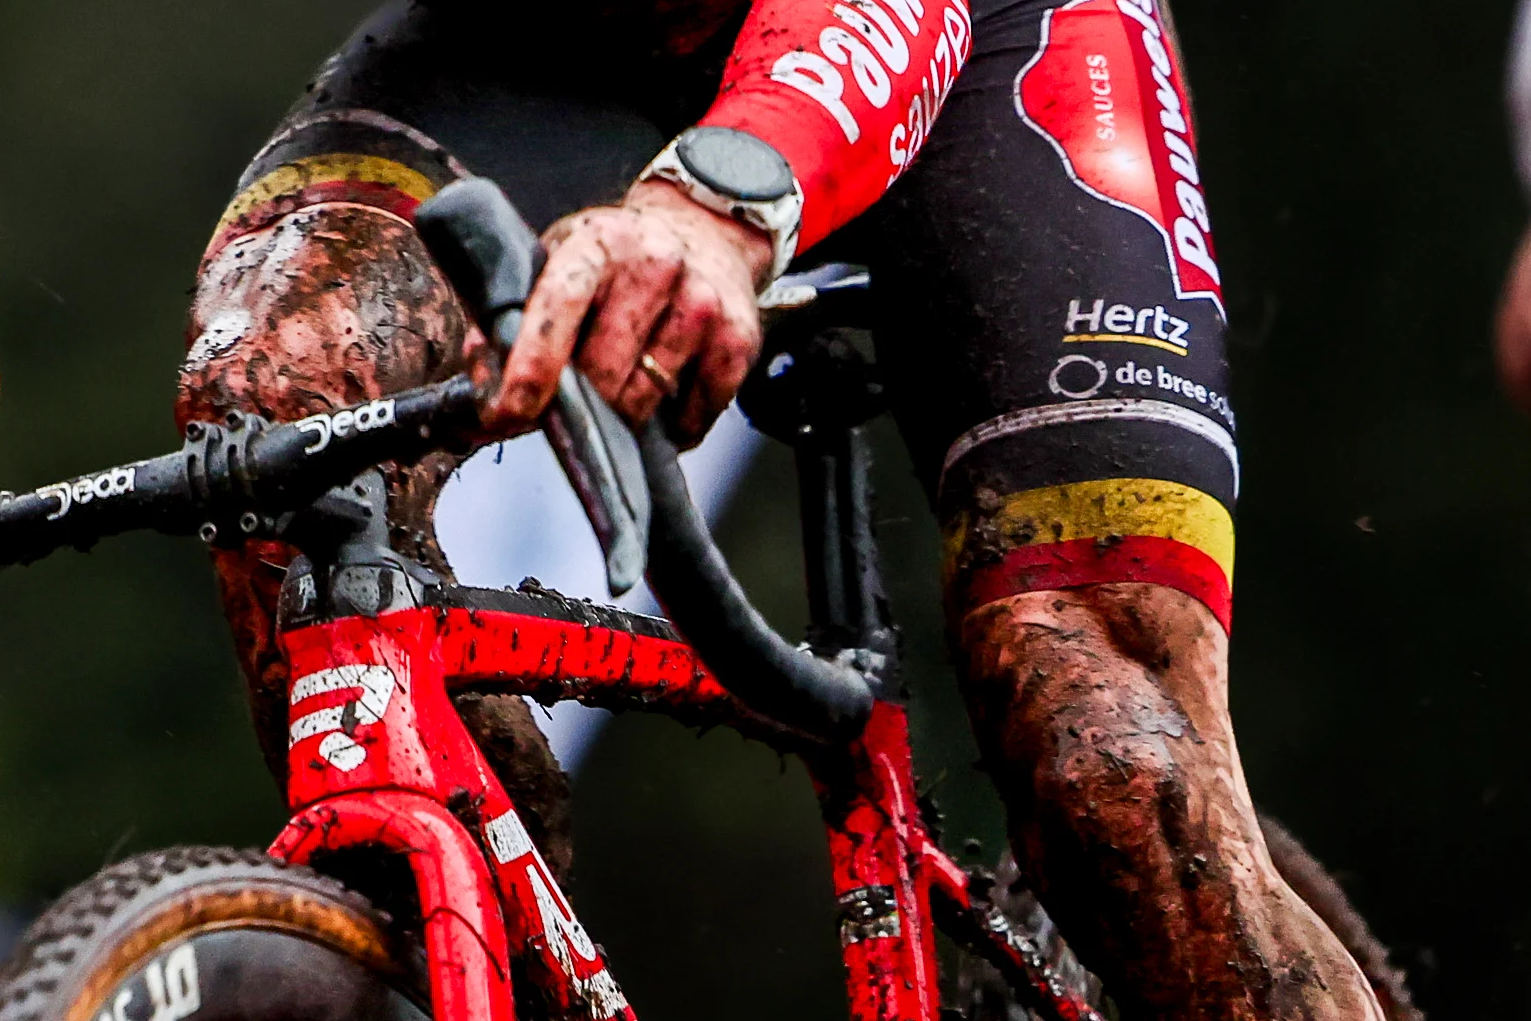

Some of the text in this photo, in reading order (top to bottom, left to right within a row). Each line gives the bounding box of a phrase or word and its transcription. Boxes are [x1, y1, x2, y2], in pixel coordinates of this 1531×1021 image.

[1085, 53, 1116, 143] SAUCES
[1066, 298, 1191, 349] Hertz
[1115, 360, 1209, 404] de bree
